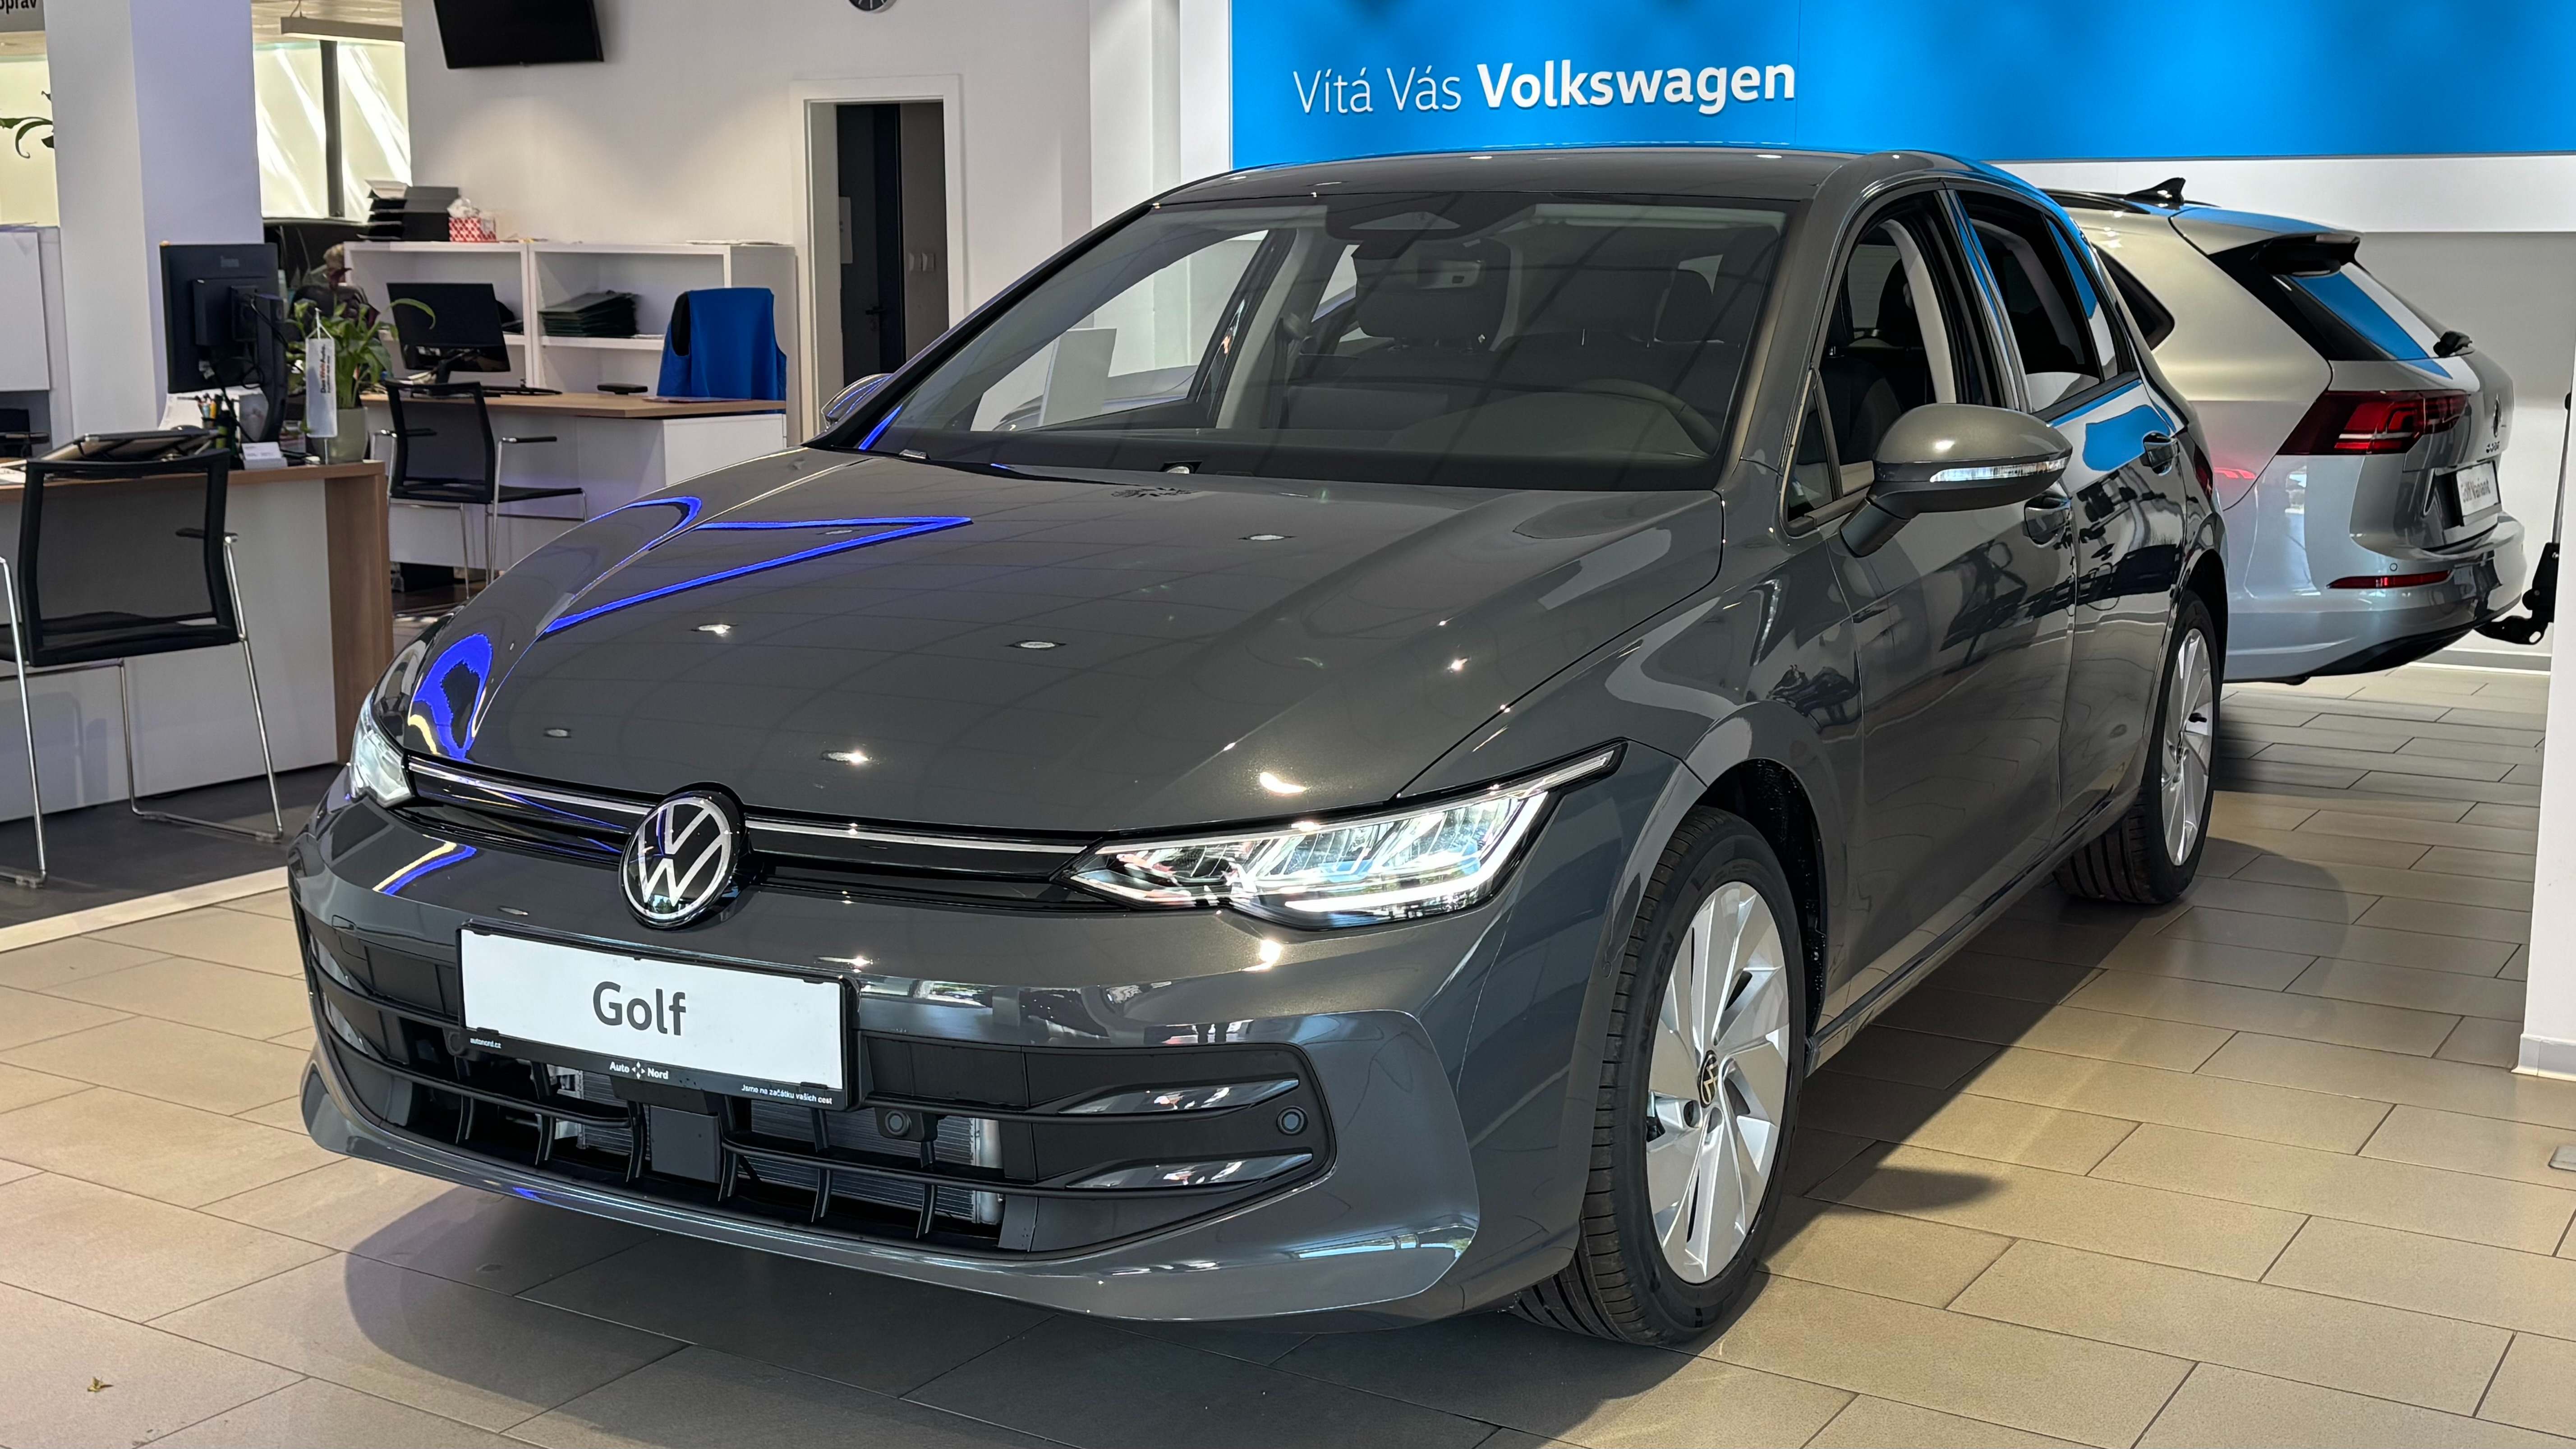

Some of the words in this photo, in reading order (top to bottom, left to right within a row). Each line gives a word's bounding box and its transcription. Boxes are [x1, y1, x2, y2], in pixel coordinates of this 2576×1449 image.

[1293, 66, 1372, 114] Vítá
[1386, 65, 1462, 112] Vás
[1477, 60, 1795, 115] Volkswagen
[593, 982, 686, 1036] Golf
[610, 1061, 630, 1073] Auto
[648, 1067, 669, 1080] Nord
